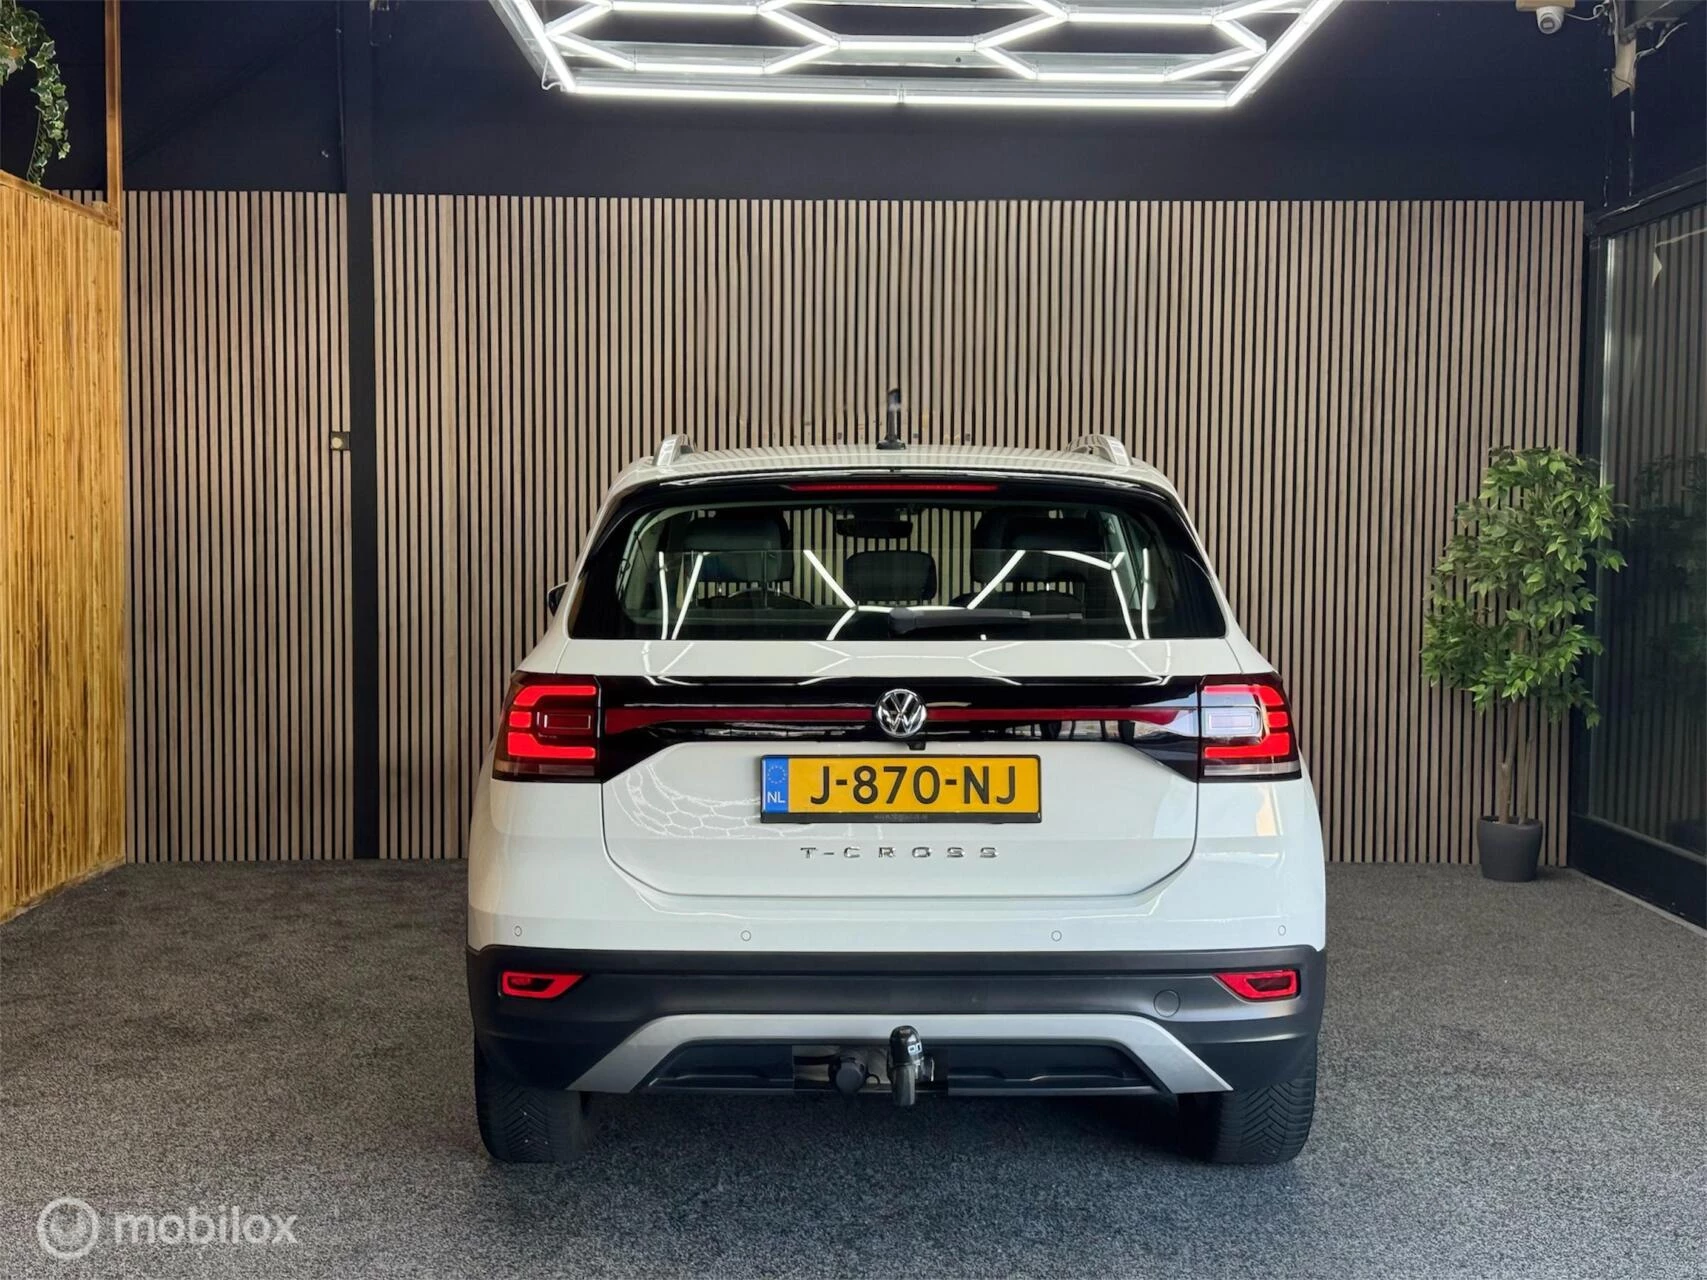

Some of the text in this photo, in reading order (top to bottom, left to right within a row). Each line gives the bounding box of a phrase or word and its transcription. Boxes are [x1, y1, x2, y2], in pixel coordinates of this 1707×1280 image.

[810, 765, 1016, 805] J-870-NJ
[767, 791, 786, 803] NL
[800, 846, 1000, 859] T-CROSS
